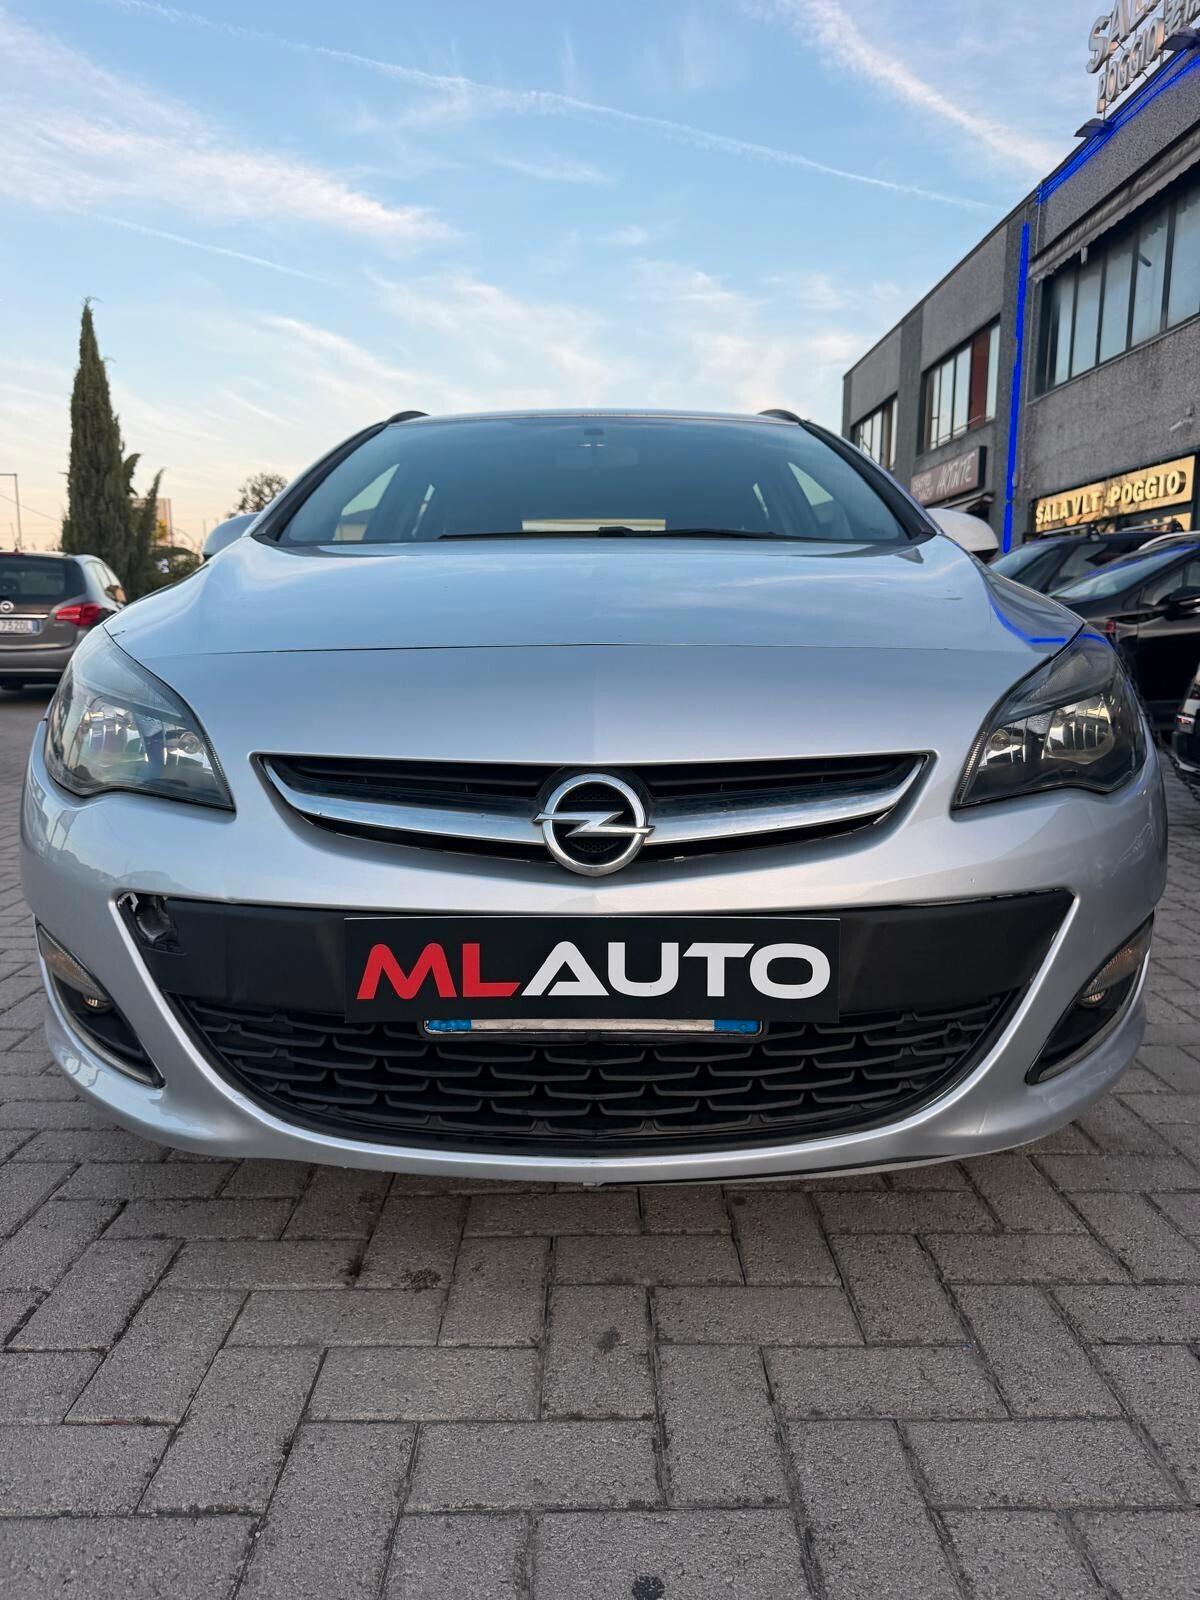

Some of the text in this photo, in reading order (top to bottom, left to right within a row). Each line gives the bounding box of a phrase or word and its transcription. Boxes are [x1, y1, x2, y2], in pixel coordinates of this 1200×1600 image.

[1097, 17, 1164, 113] POGGIO
[1036, 470, 1182, 525] SALA VLT POGGIO
